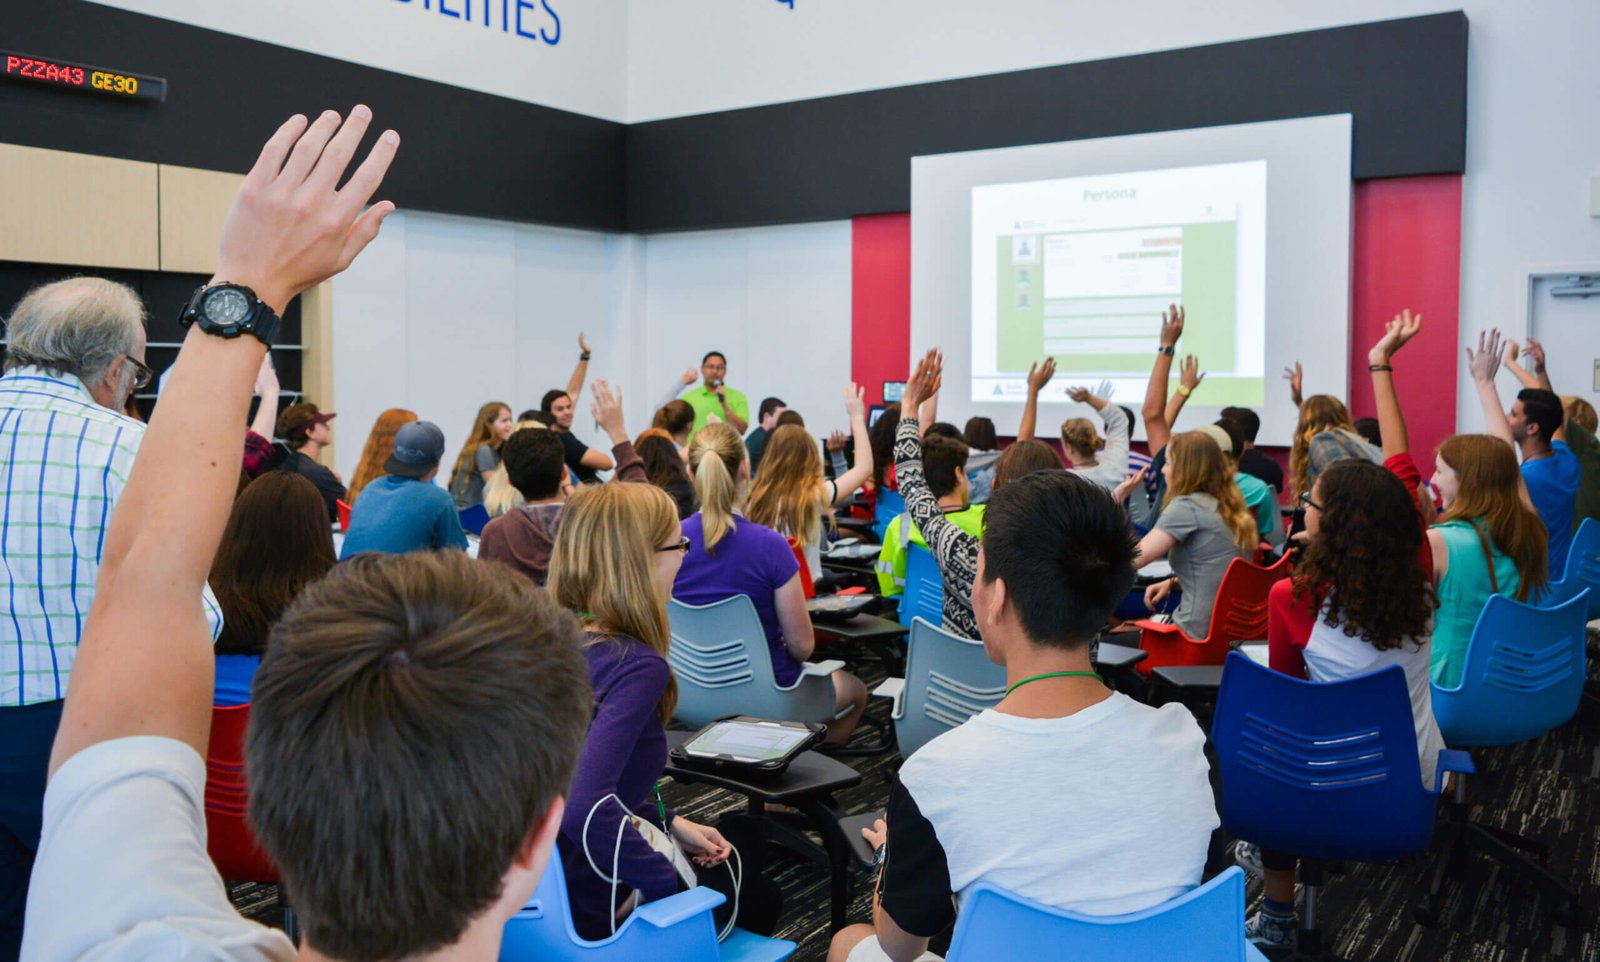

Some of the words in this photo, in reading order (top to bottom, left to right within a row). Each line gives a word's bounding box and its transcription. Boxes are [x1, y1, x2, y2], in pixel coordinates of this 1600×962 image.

[7, 56, 85, 85] PZZA43
[91, 71, 138, 95] GE30
[1083, 187, 1137, 202] Persona
